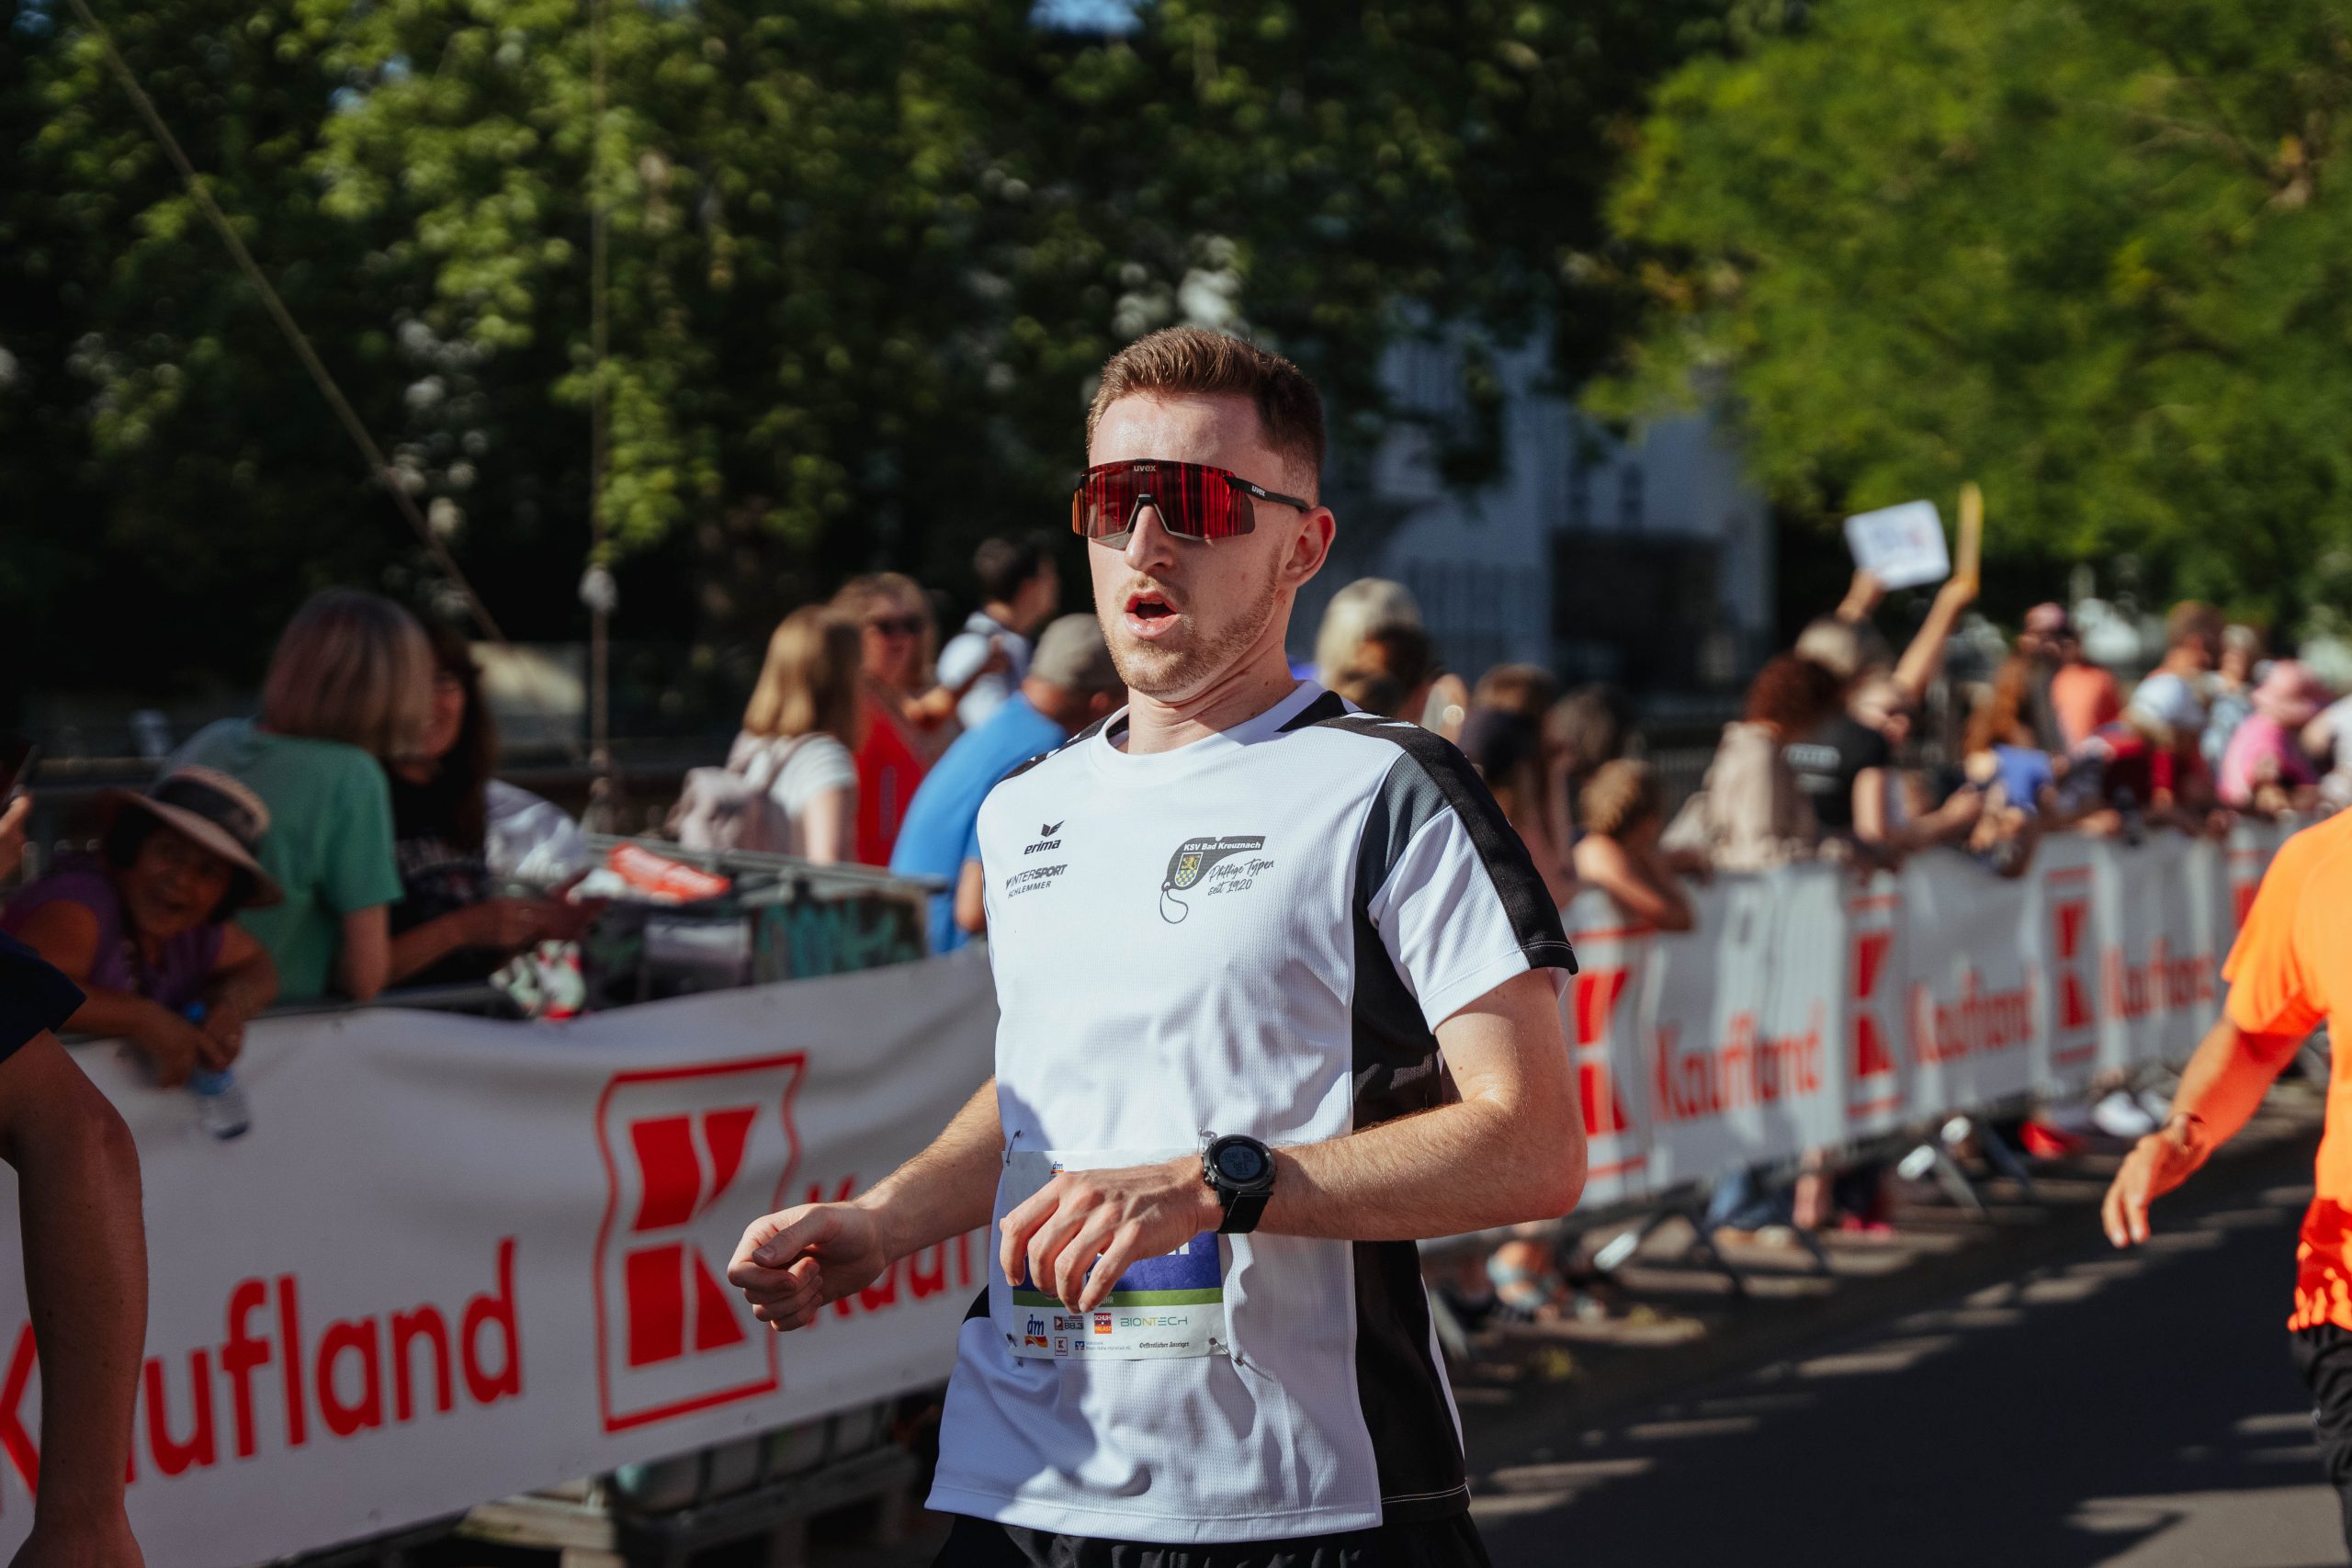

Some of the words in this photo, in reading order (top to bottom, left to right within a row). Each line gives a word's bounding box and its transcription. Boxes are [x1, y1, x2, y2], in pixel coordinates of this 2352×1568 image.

[1251, 485, 1266, 497] uvex
[1023, 840, 1061, 854] erima
[1183, 843, 1201, 852] KSV
[1202, 842, 1216, 851] Bad
[1217, 841, 1261, 850] Kreuznach
[1244, 858, 1274, 877] Typen
[1227, 879, 1252, 894] 1920
[1027, 1314, 1045, 1336] dm
[1120, 1316, 1188, 1327] BIONTECH
[0, 1235, 524, 1516] Kufland
